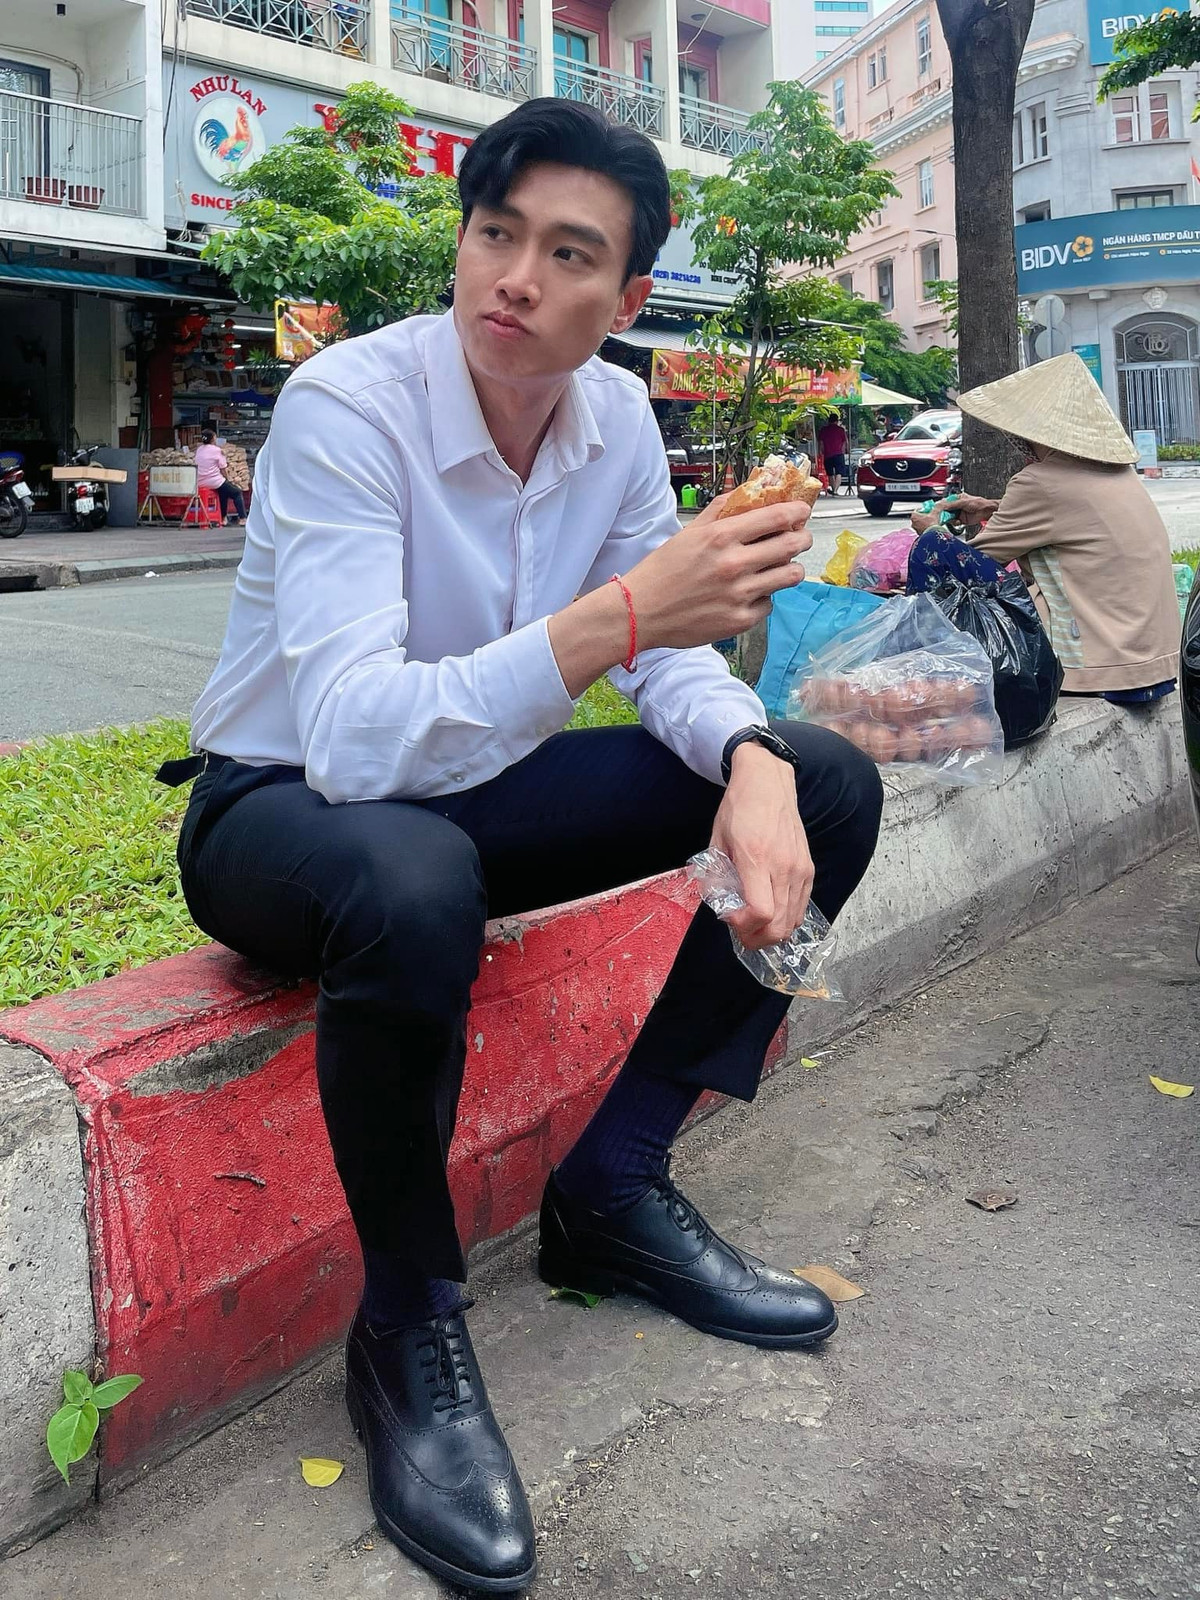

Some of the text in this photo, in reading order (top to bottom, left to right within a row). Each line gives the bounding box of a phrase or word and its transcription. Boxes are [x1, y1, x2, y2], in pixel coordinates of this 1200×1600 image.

[190, 75, 267, 116] NHƯ LAN
[191, 193, 233, 211] SINCE
[1152, 232, 1176, 241] TMCP
[1021, 242, 1073, 271] BIDV
